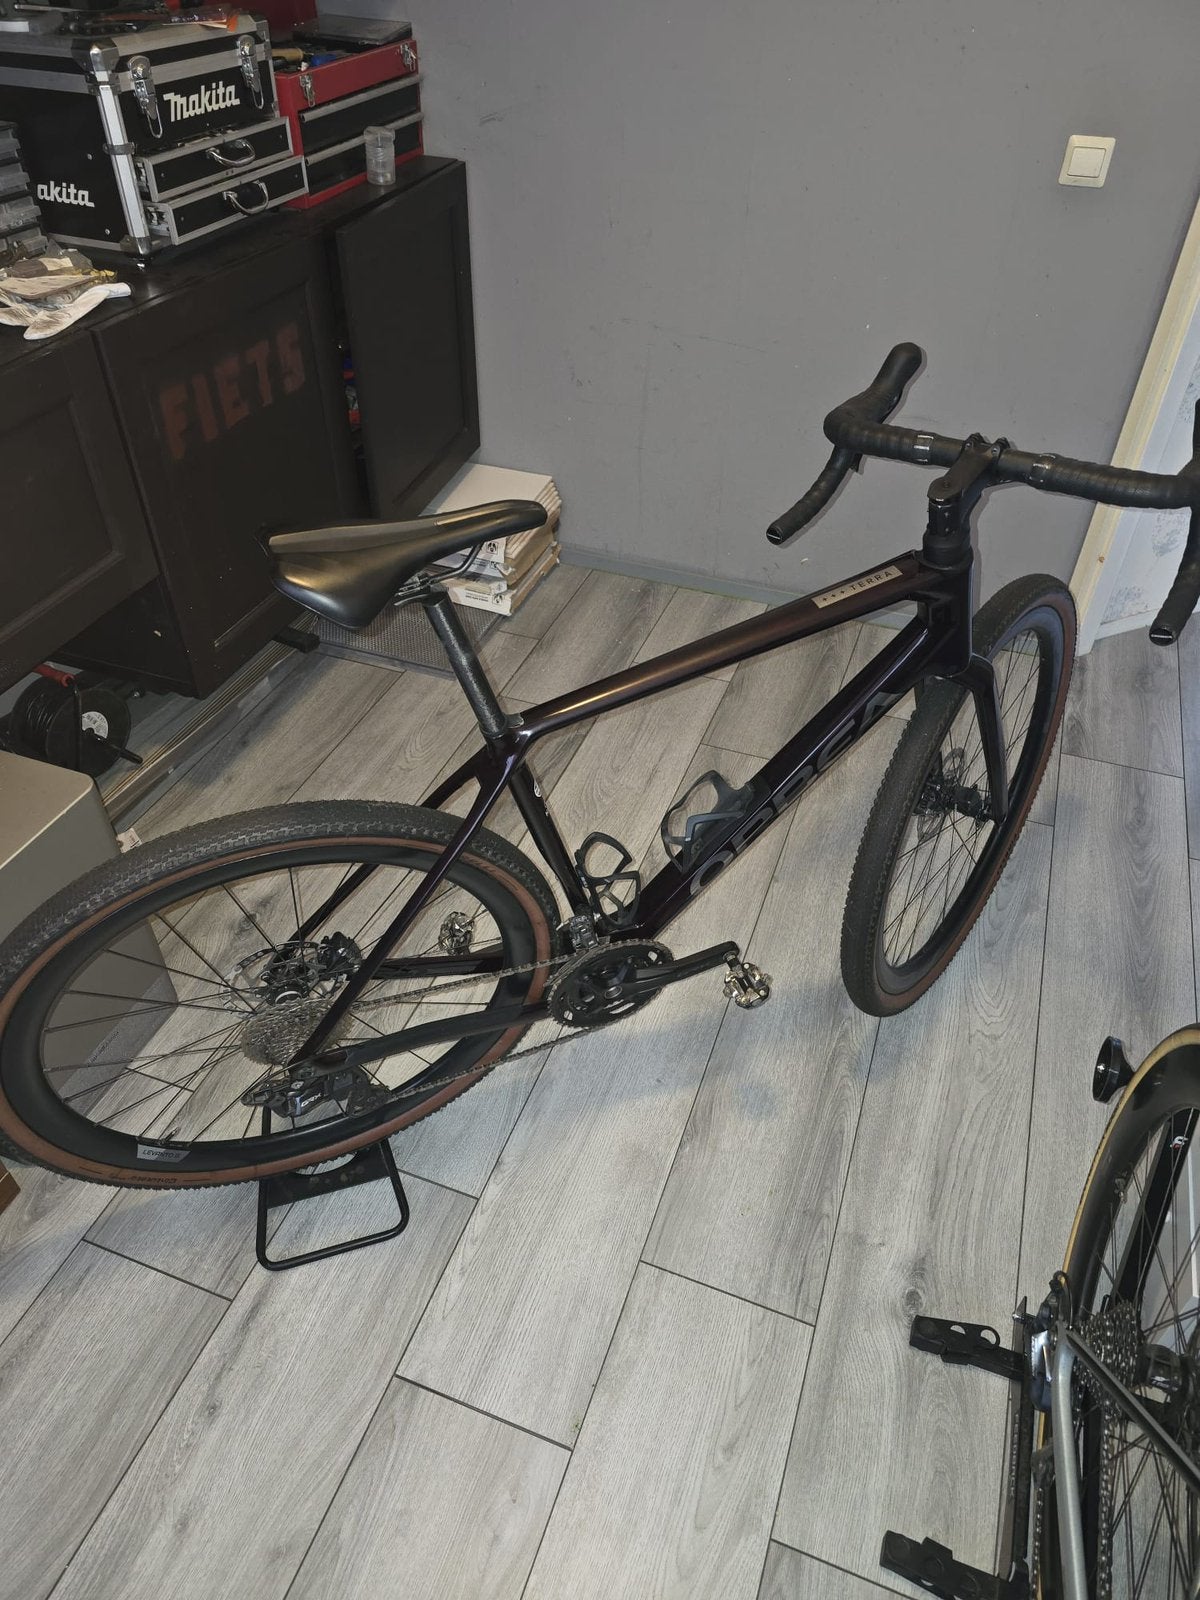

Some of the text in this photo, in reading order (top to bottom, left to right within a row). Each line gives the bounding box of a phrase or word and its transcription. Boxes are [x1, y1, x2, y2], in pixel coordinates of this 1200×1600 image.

[162, 80, 241, 123] Makita
[158, 321, 306, 460] FIETS
[850, 571, 893, 591] TERRA
[300, 1092, 321, 1108] GRX
